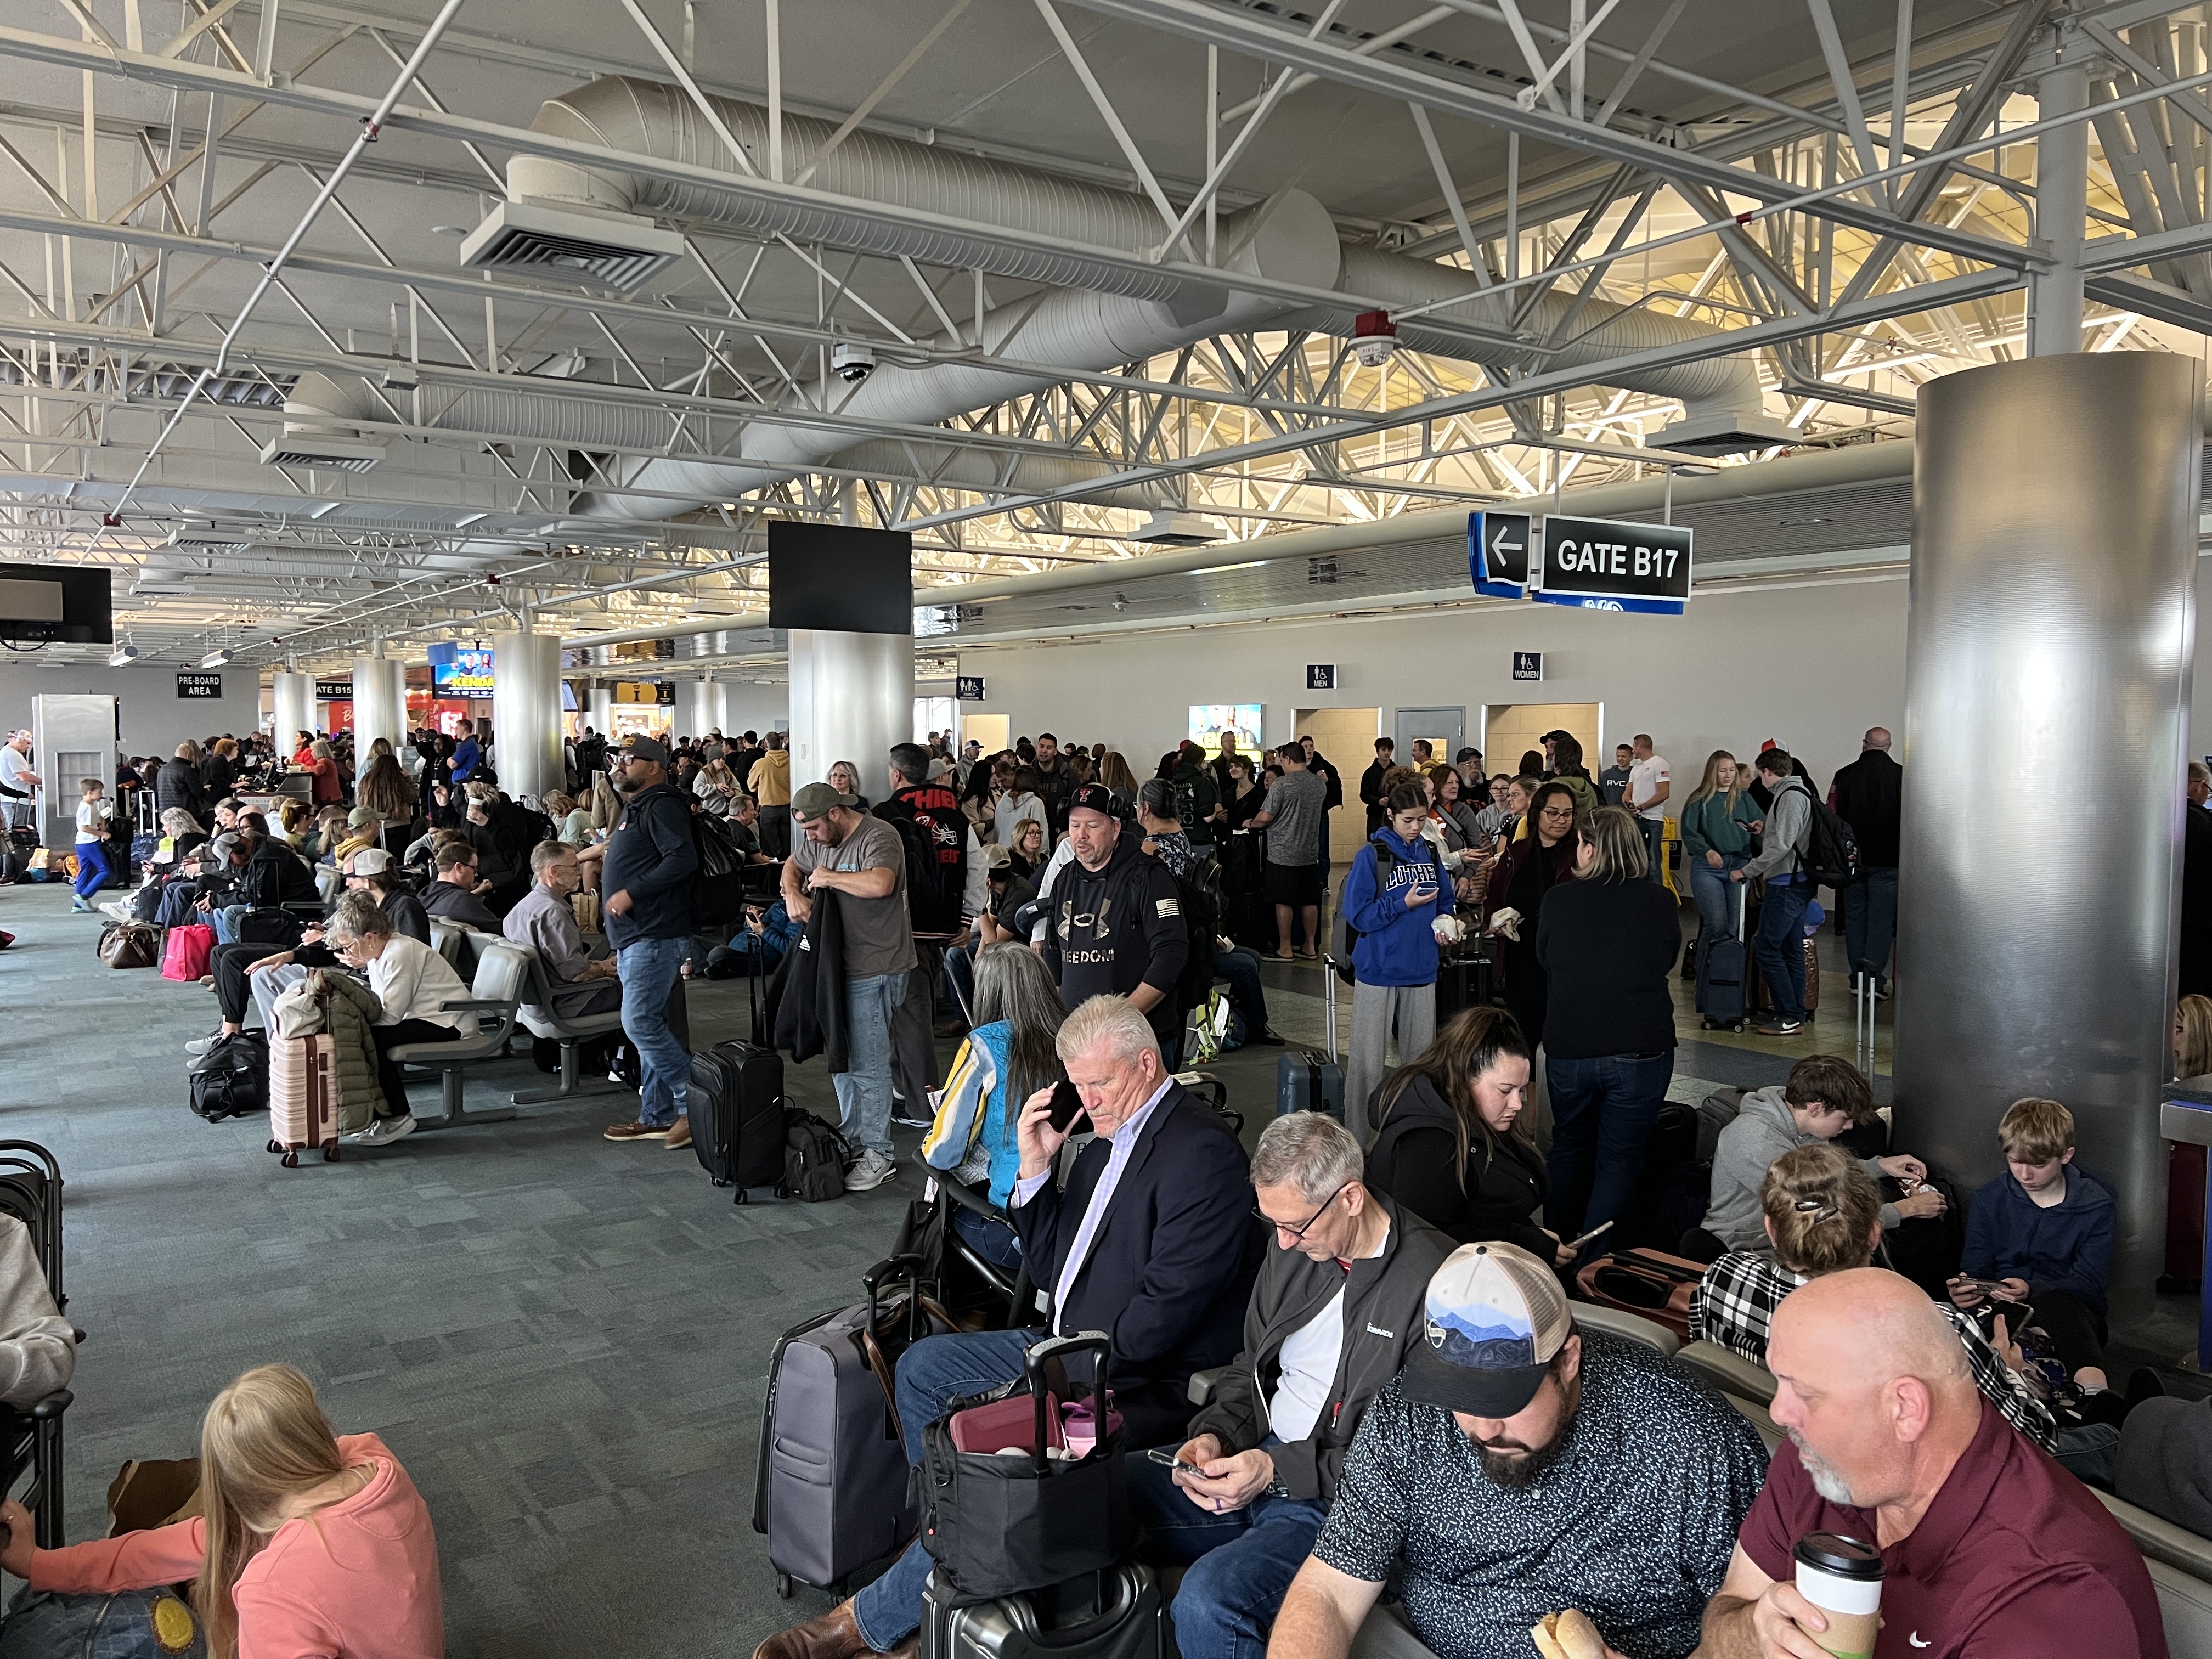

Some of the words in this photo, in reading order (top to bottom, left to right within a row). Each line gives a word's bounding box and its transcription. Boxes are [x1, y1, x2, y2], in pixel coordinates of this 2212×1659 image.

[1558, 540, 1627, 574] GATE
[1634, 546, 1679, 578] B17
[1515, 670, 1539, 679] WOMEN
[178, 676, 219, 685] PRE-BOARD
[452, 677, 494, 687] KENDA
[188, 687, 211, 695] AREA
[1386, 863, 1437, 891] LUTHE
[1062, 948, 1114, 963] REEDOM
